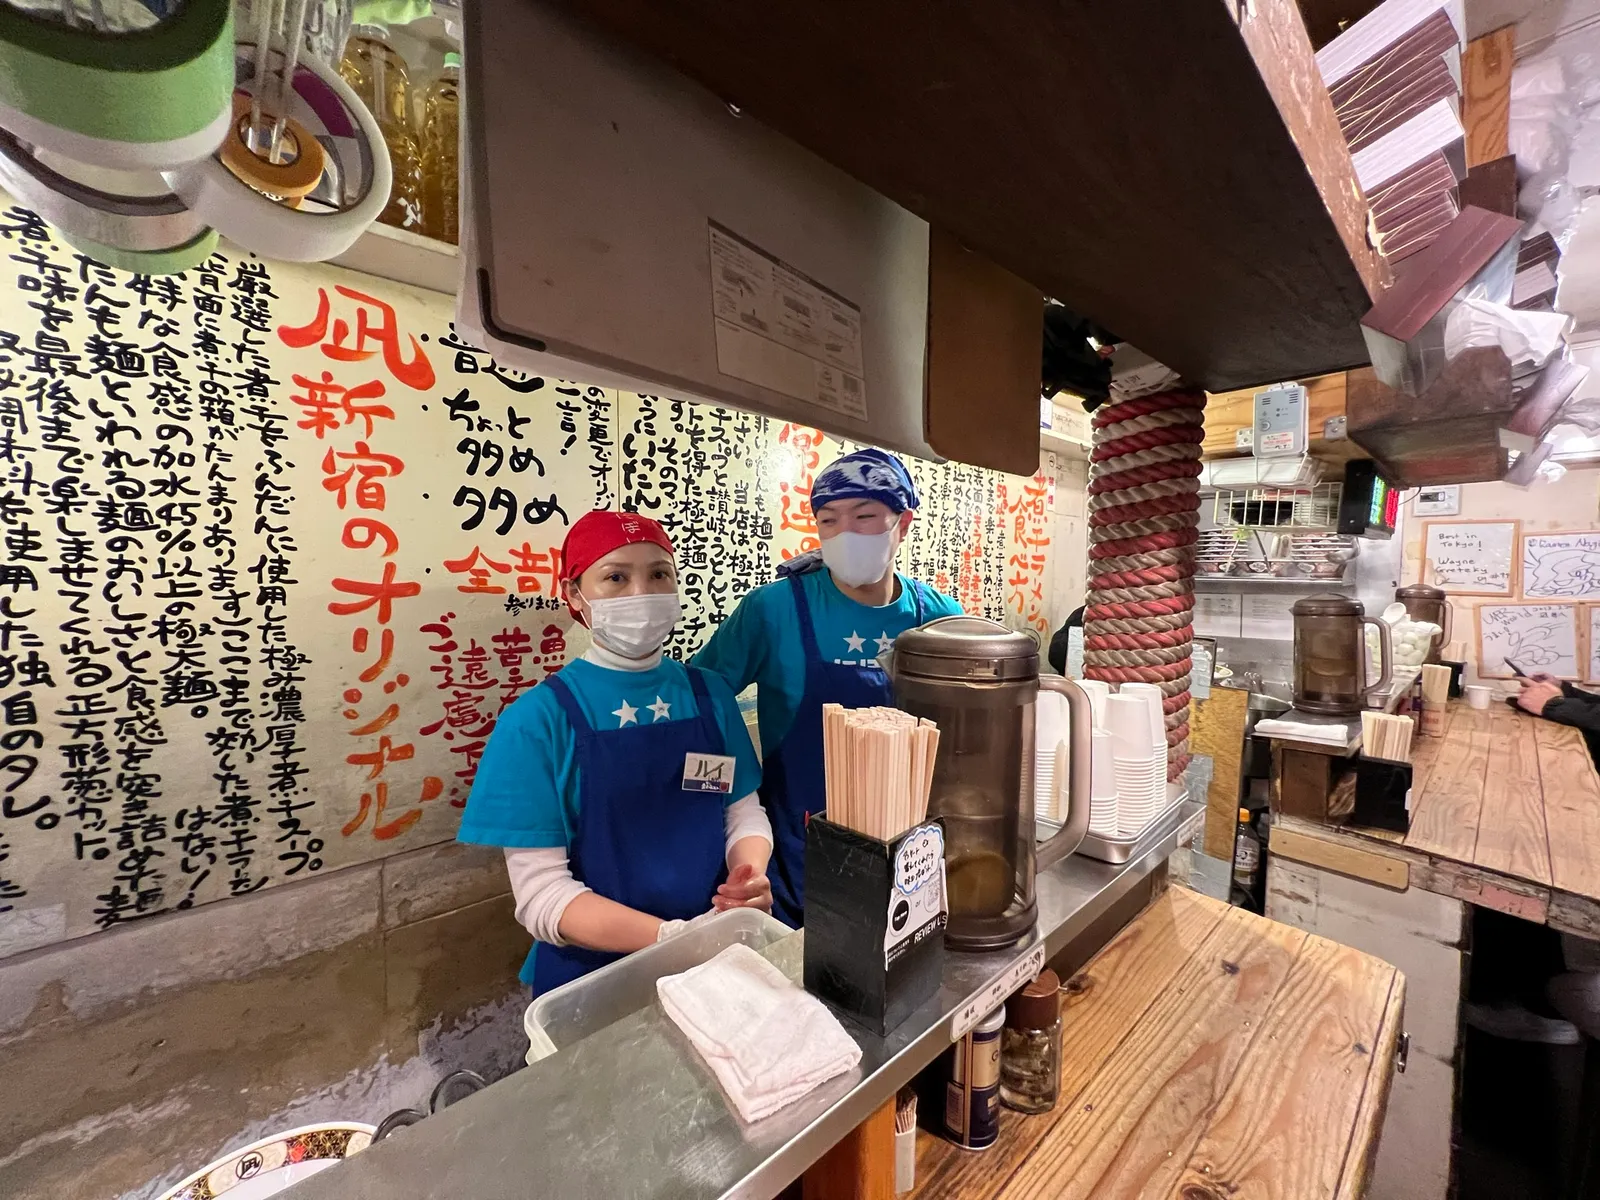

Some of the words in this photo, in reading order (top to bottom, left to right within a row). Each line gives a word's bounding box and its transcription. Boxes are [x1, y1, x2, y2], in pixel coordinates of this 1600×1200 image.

[456, 437, 546, 477] 多め
[452, 485, 570, 536] 多め
[277, 284, 444, 841] 凪新宿のオリジナル
[1008, 494, 1030, 615] 食べ方
[914, 919, 937, 944] REVIEW
